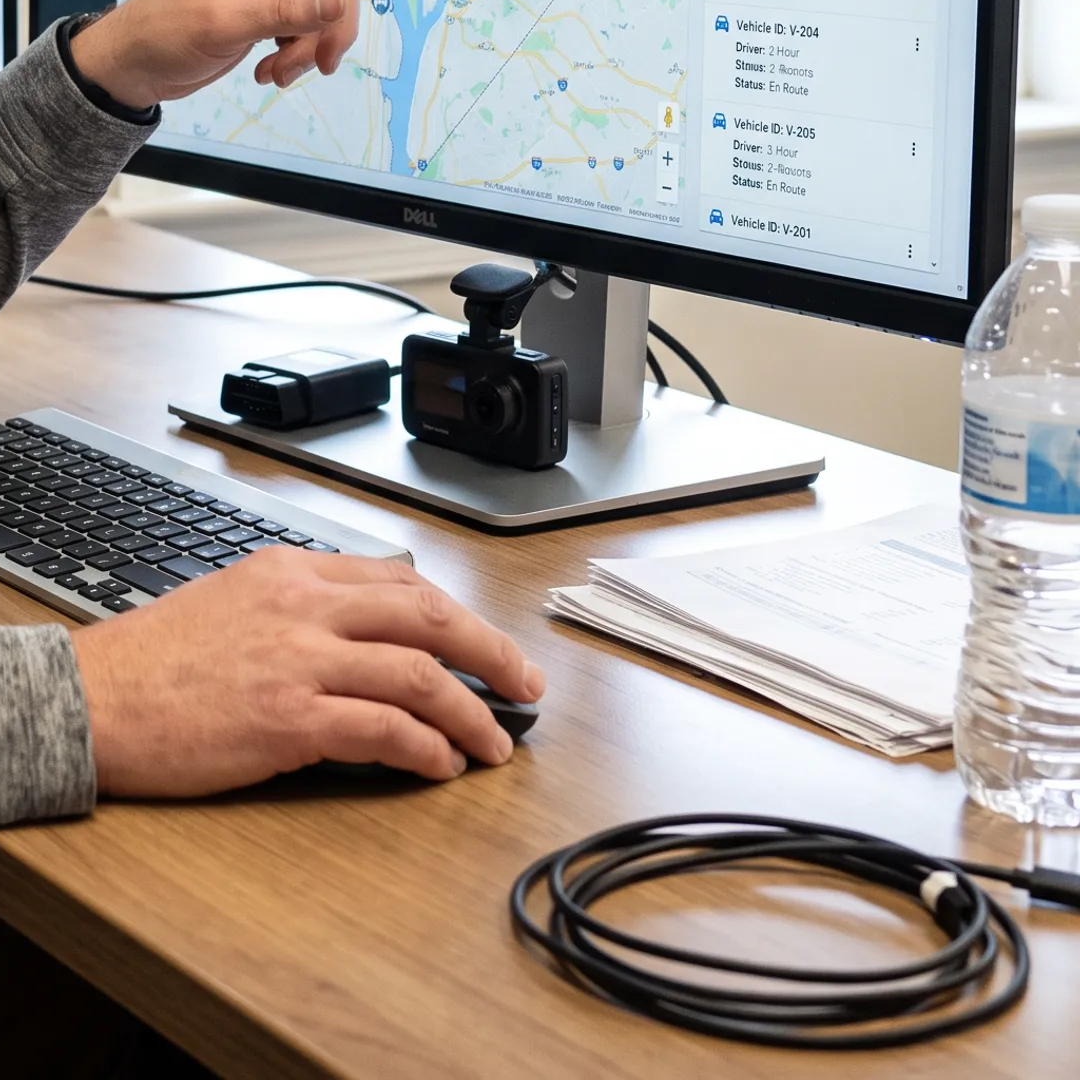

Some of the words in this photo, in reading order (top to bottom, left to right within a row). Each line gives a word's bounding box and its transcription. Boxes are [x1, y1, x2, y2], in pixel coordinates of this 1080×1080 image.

[736, 20, 771, 34] Vehicle
[774, 23, 786, 36] ID:
[789, 24, 819, 39] V-204
[736, 42, 766, 55] Driver:
[769, 45, 775, 57] 2
[777, 46, 800, 58] Hour
[734, 76, 766, 90] Status:
[769, 81, 781, 92] En
[783, 82, 809, 96] Route
[733, 118, 769, 133] Vehicle
[771, 122, 784, 135] ID:
[785, 125, 816, 139] V-205
[733, 139, 763, 154] Driver:
[776, 145, 799, 158] Hour
[732, 174, 763, 189] Status:
[766, 179, 778, 191] En
[780, 182, 806, 196] Route
[403, 207, 437, 228] DELL
[731, 214, 766, 231] Vehicle
[768, 220, 780, 234] ID:
[782, 223, 811, 239] V-201
